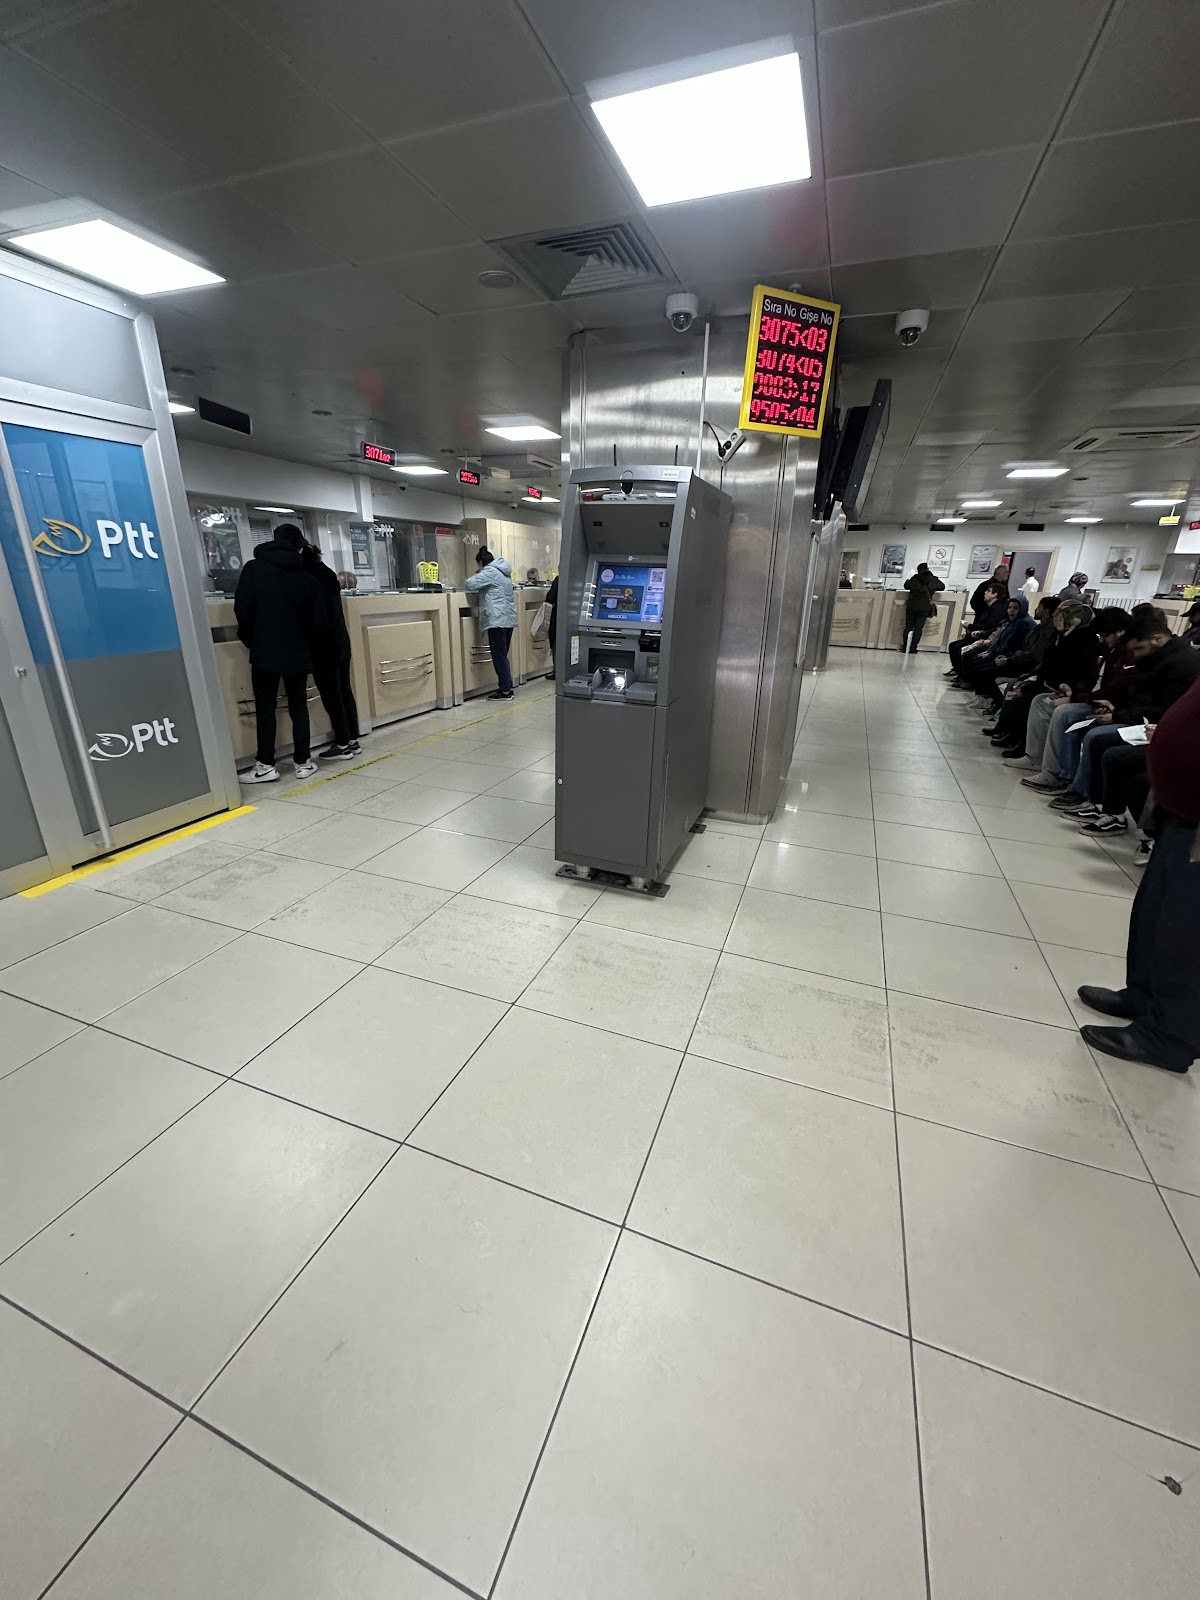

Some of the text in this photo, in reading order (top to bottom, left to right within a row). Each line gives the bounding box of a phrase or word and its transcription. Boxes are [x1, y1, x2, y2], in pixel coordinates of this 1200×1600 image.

[764, 299, 833, 325] Sıra No Gişe No
[96, 519, 159, 560] Ptt
[381, 523, 394, 539] Ptt
[132, 717, 180, 753] Ptt
